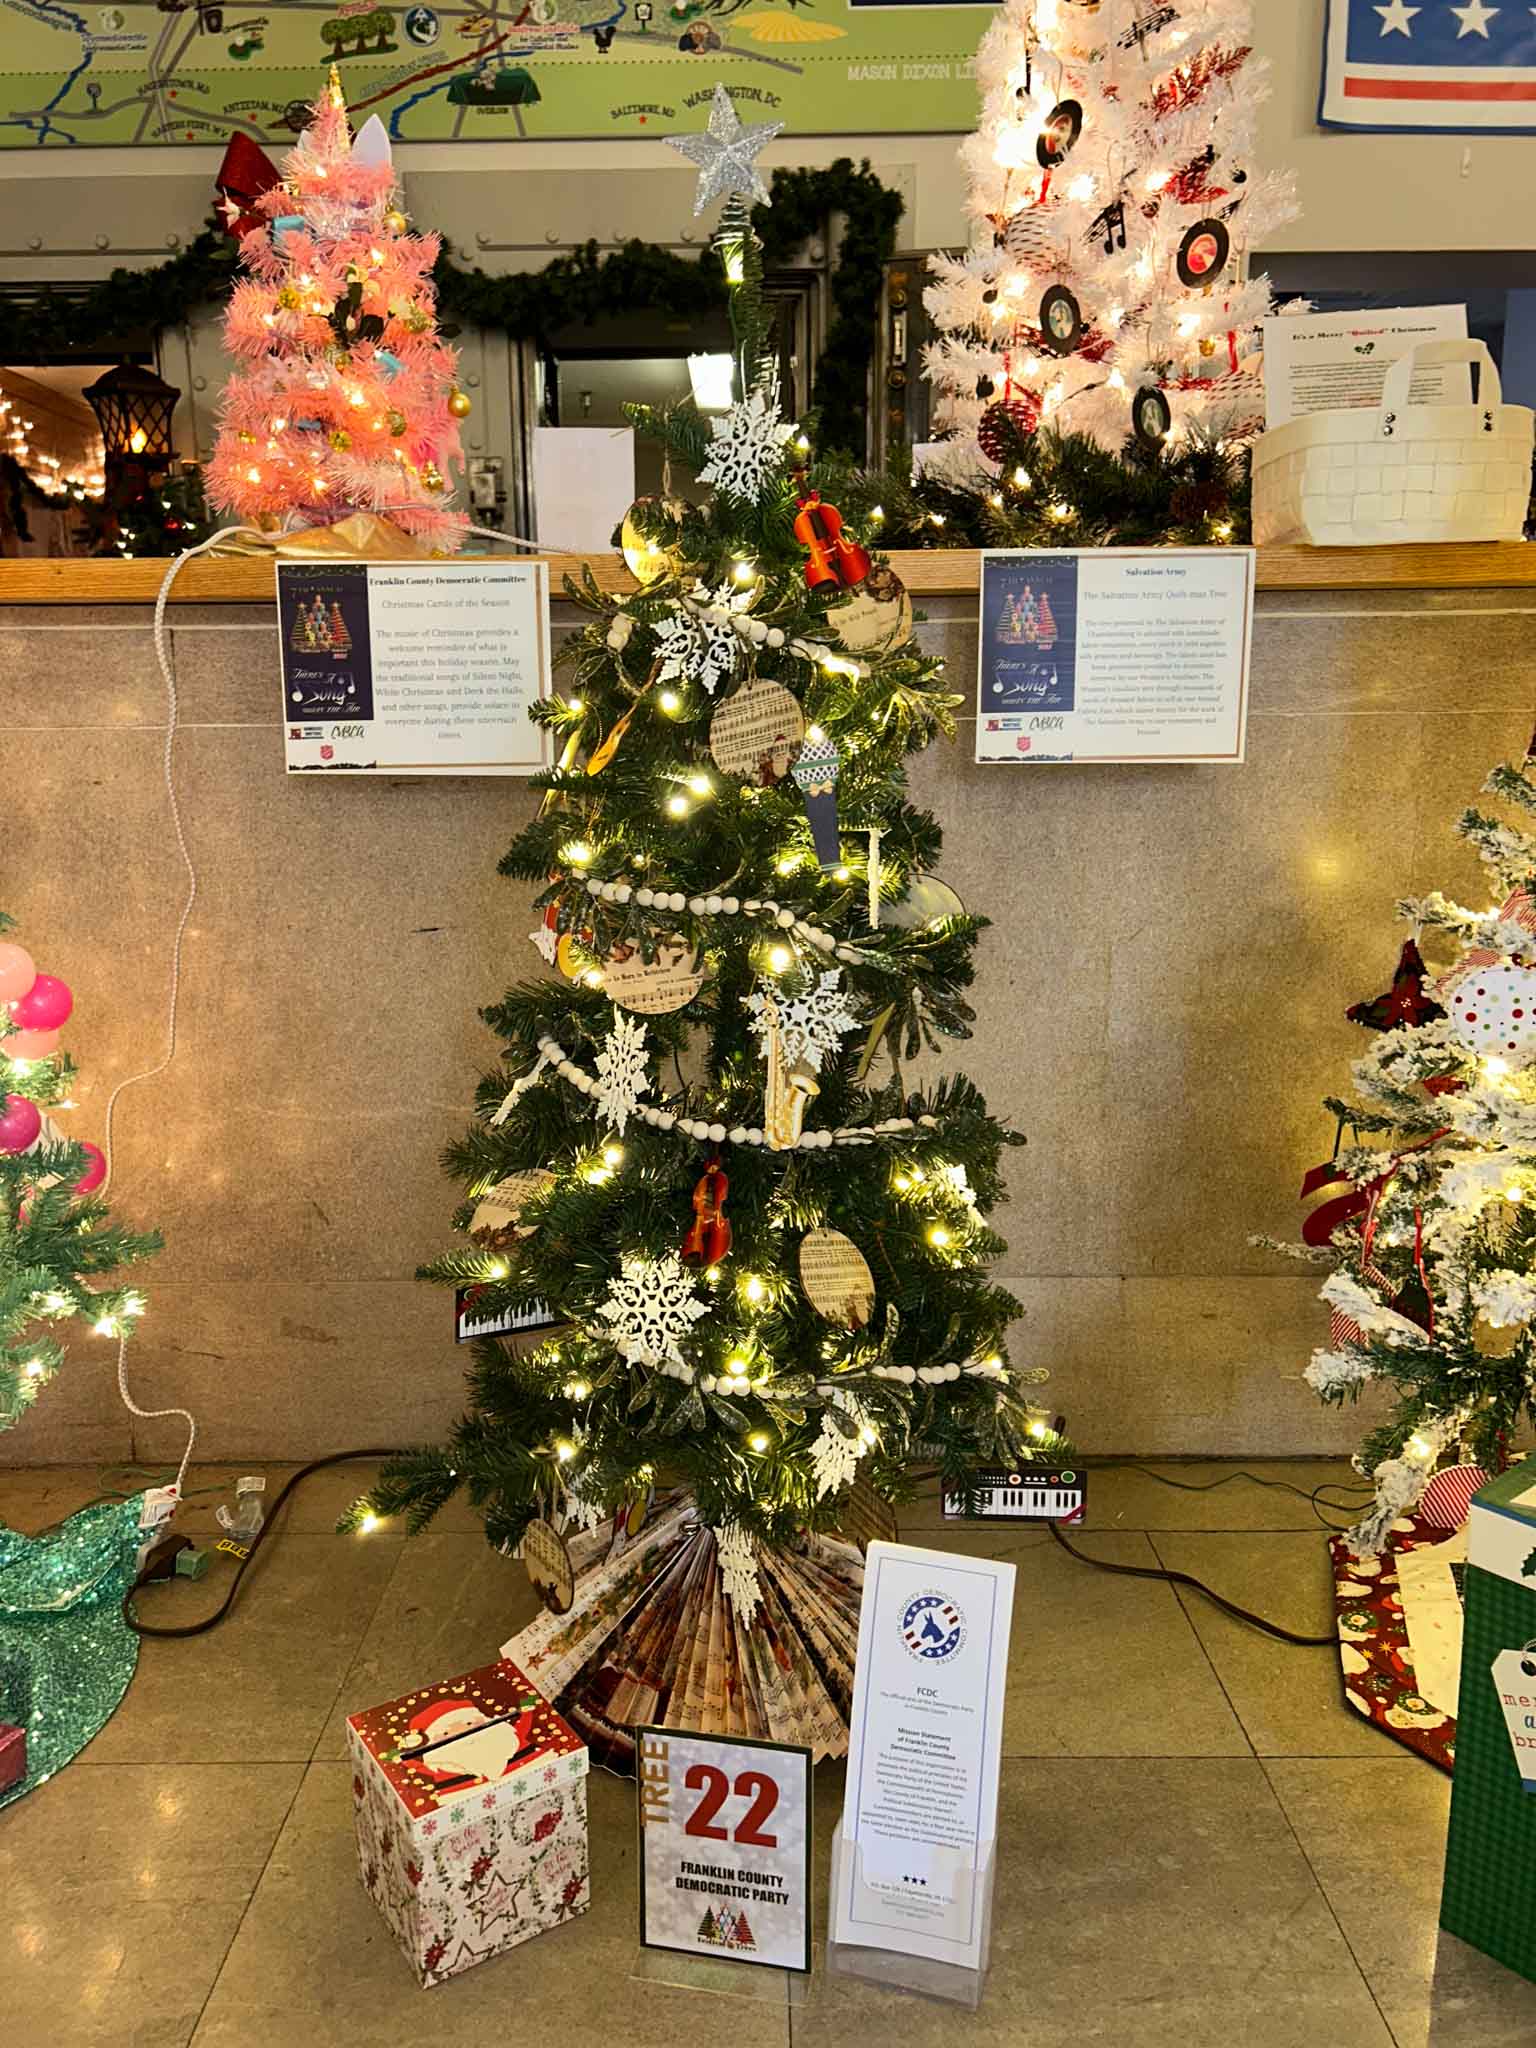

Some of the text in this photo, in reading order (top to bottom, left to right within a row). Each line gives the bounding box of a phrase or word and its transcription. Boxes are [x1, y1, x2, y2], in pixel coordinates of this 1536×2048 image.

[847, 64, 897, 80] MASON
[902, 63, 950, 80] DIXON
[1125, 567, 1187, 578] Salvation Army
[369, 575, 527, 587] Franklin County Democratic Committee
[381, 599, 424, 609] Christmas
[465, 598, 479, 608] the
[480, 597, 511, 608] Season
[431, 628, 474, 638] Christmas
[503, 657, 520, 667] May
[916, 1686, 939, 1698] FCDC
[924, 1749, 956, 1760] Committee
[640, 1741, 670, 1828] TREE
[684, 1763, 780, 1849] 22
[680, 1861, 784, 1888] FRANKLIN COUNTY
[675, 1876, 790, 1906] DEMOCRATIC PARTY
